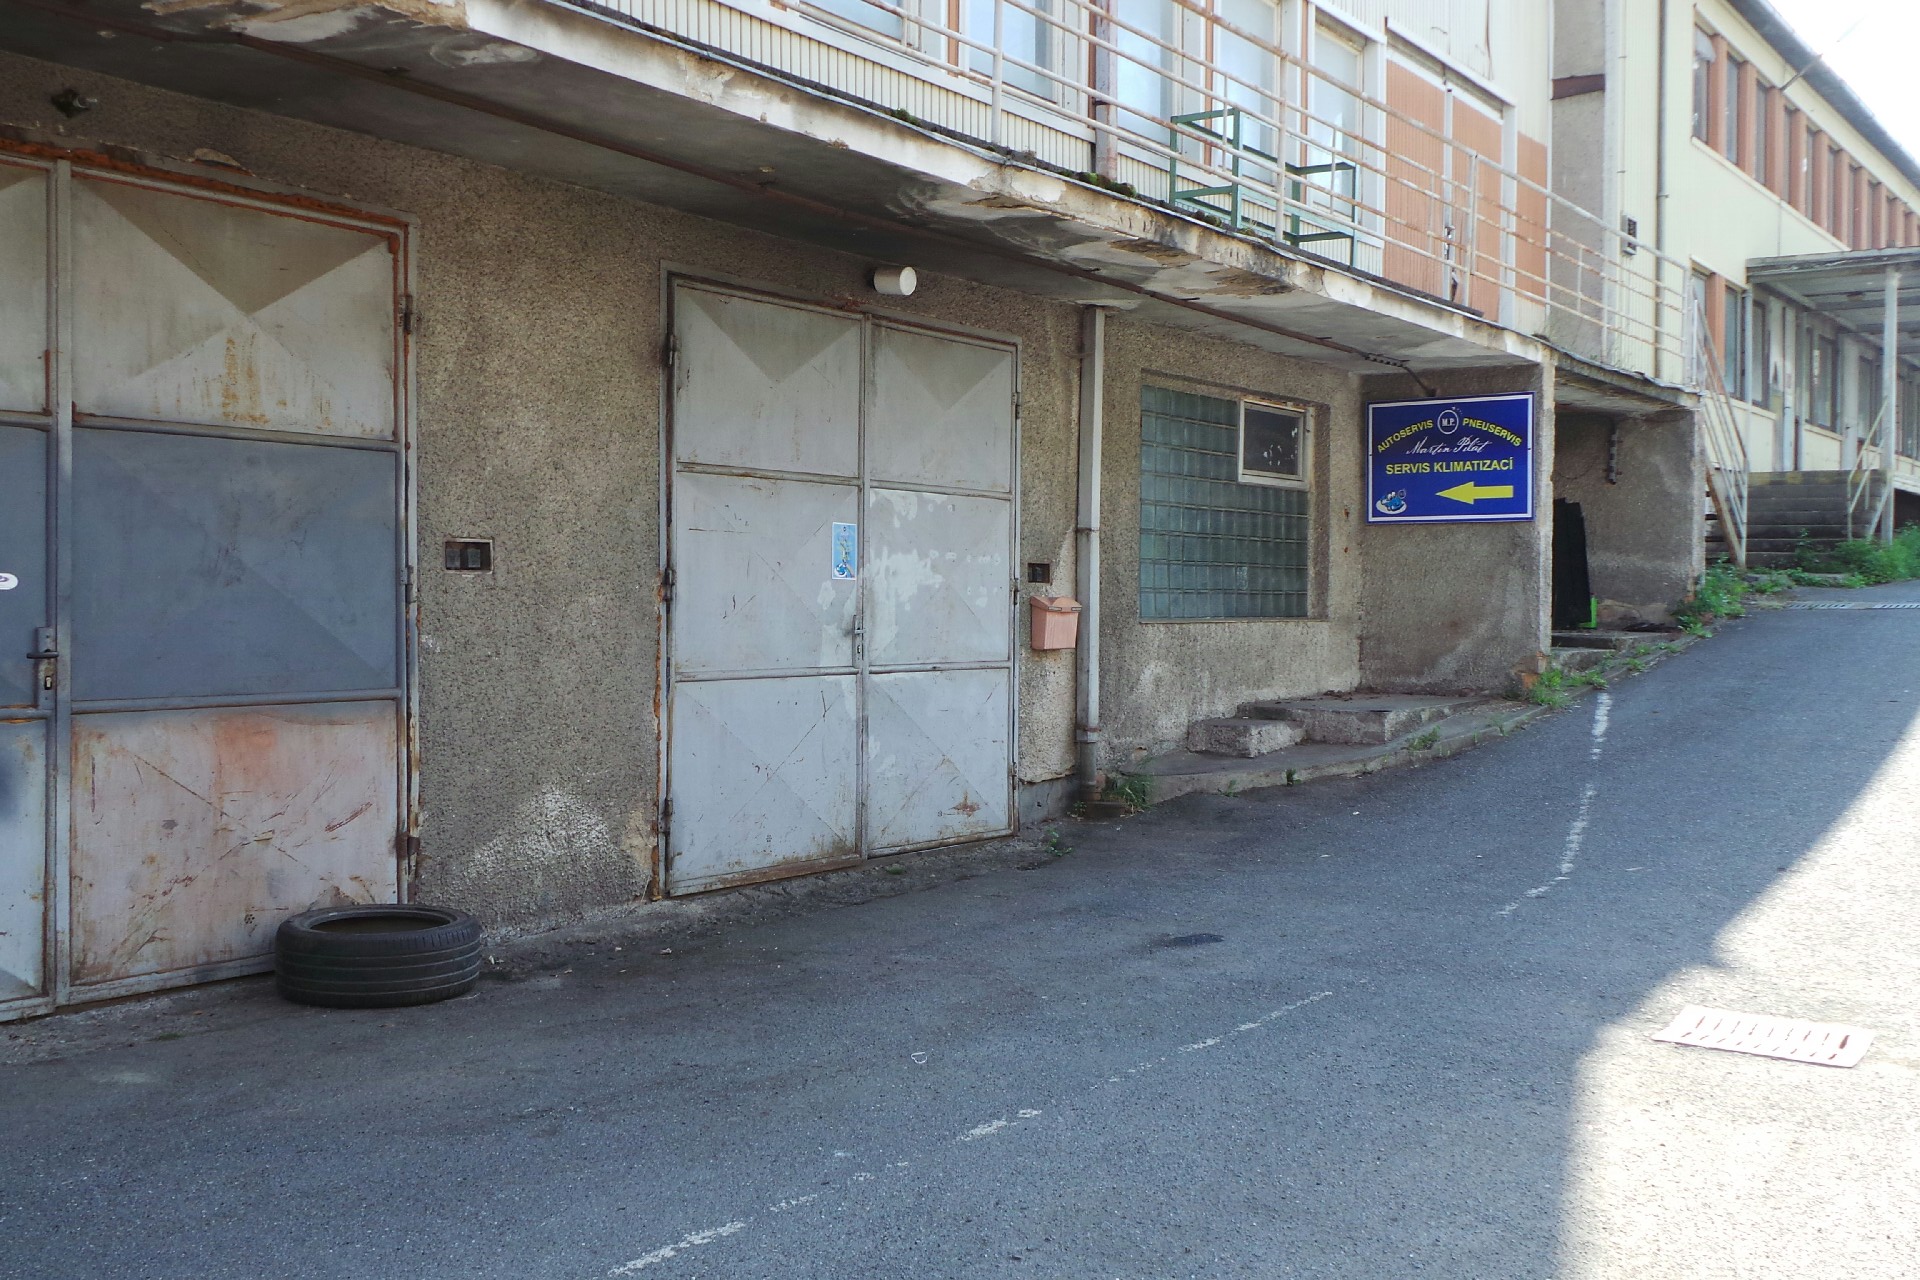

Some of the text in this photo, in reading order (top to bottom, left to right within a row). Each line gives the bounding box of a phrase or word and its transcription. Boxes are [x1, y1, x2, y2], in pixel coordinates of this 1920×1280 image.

[1377, 418, 1522, 453] AUTOSERVIS M.P. PNEUSERVIS
[1406, 436, 1451, 455] Martin
[1386, 457, 1513, 475] SERVIS KLIMATIZACÍ
